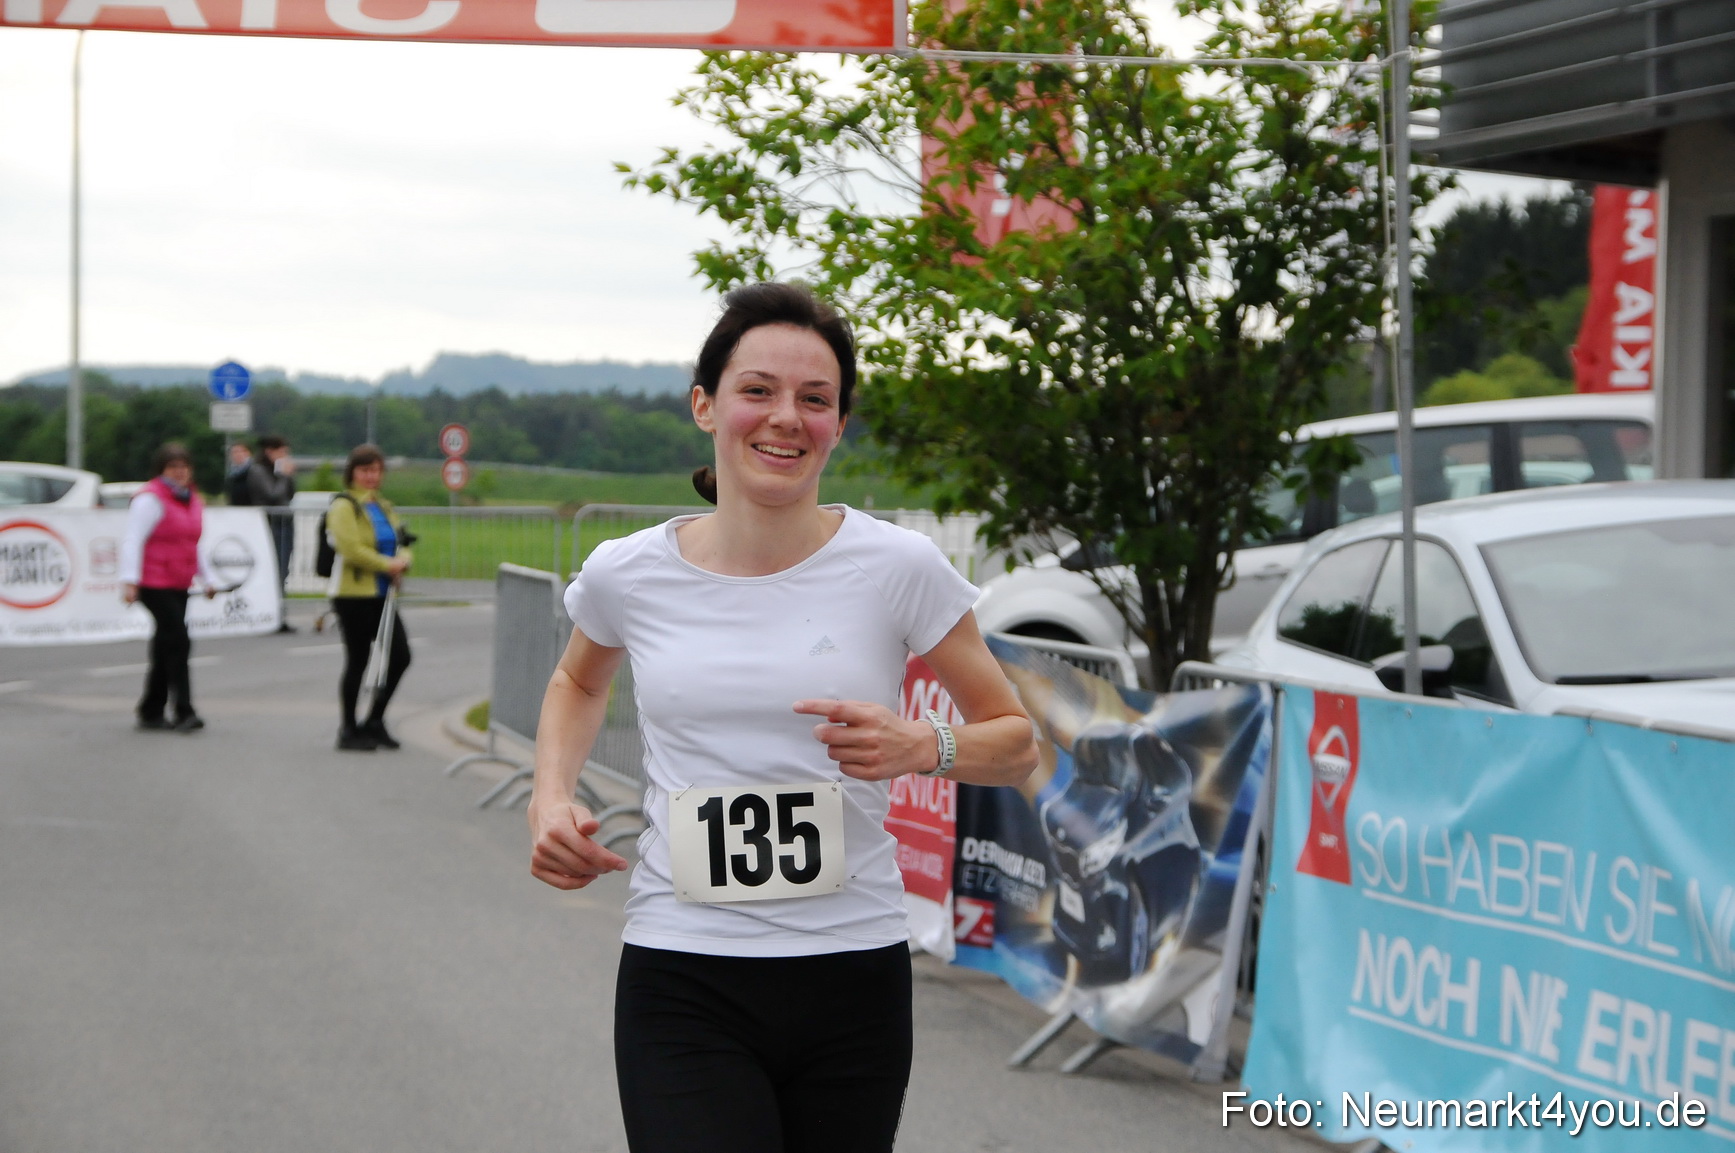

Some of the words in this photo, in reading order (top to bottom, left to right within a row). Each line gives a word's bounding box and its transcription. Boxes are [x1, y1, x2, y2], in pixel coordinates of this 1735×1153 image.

[1609, 281, 1655, 387] KIA
[697, 791, 822, 888] 135
[1356, 811, 1409, 892] SO
[1418, 823, 1598, 933] HABEN
[1604, 855, 1680, 957] SIE
[1351, 927, 1481, 1038] NOCH
[1500, 964, 1567, 1063] NIE
